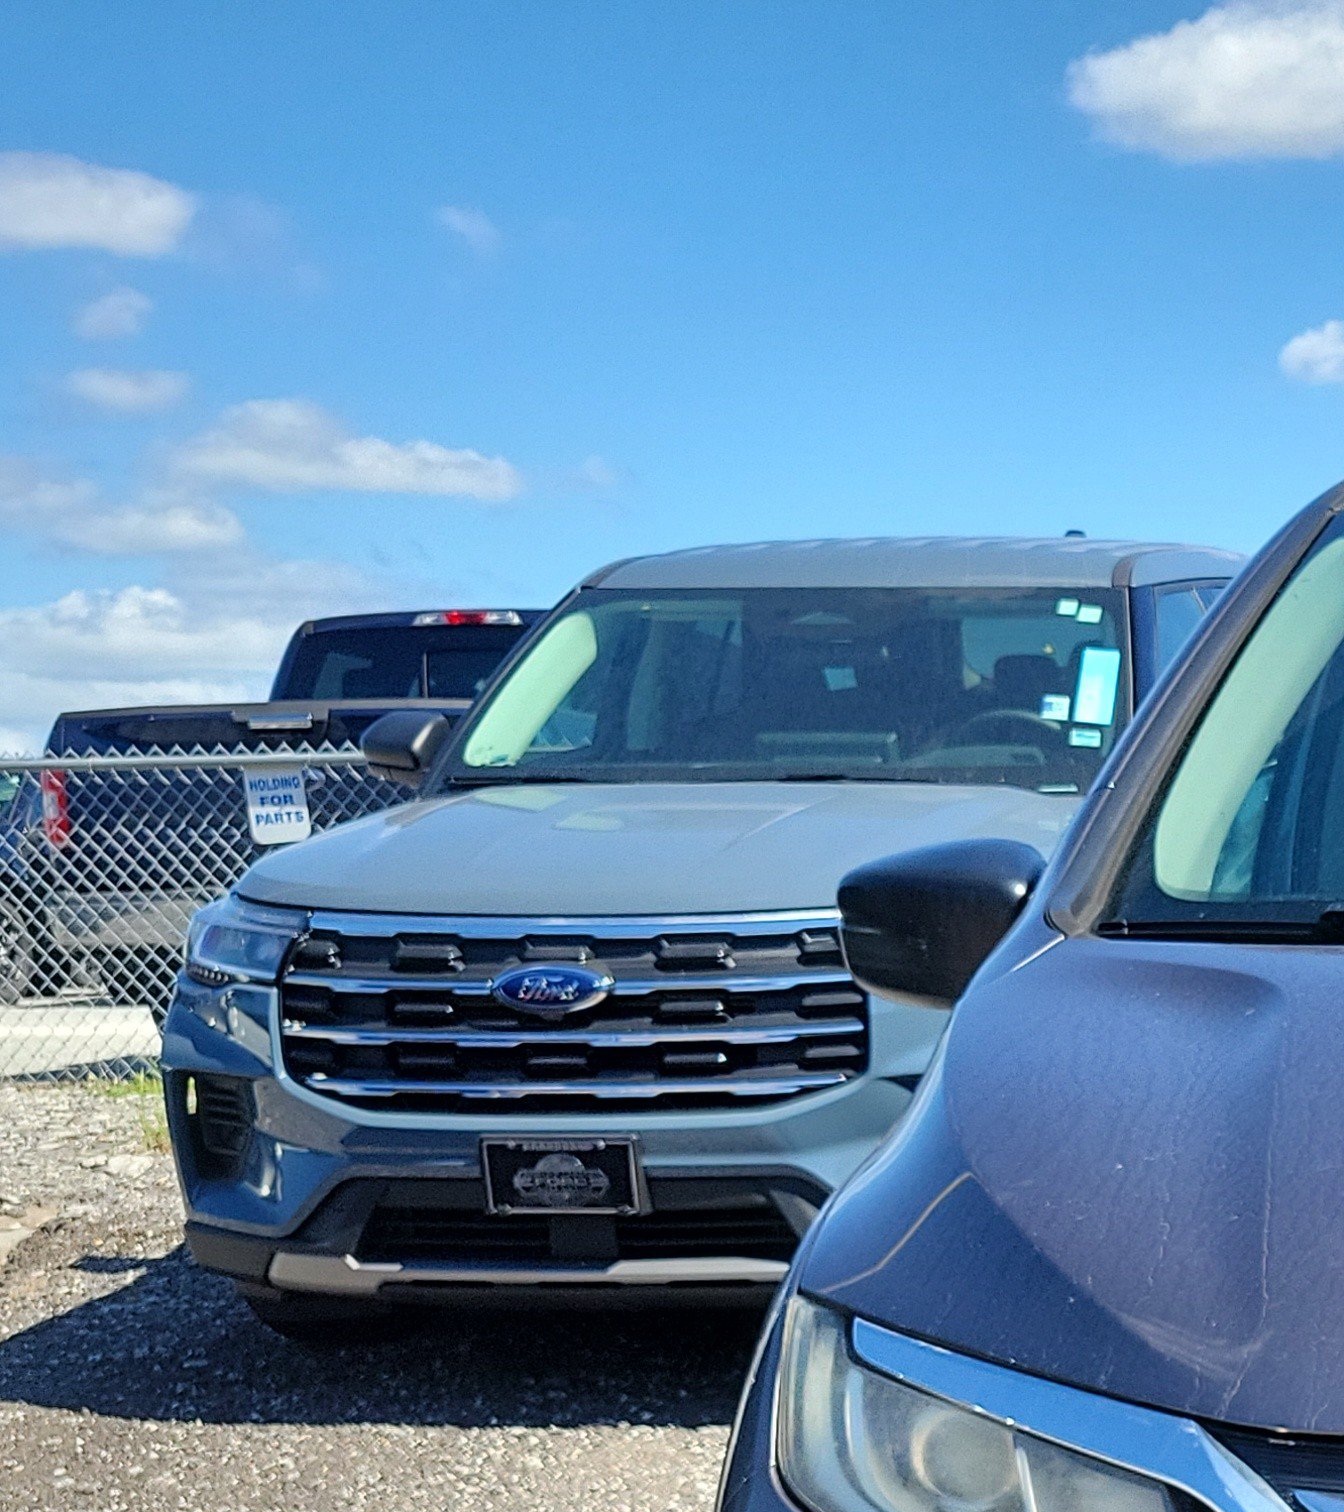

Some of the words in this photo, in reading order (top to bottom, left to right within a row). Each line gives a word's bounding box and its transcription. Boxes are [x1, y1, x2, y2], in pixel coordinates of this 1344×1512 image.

[249, 776, 300, 791] HOLDING
[259, 794, 295, 806] FOR
[255, 811, 304, 826] PARTS
[517, 977, 580, 1001] Ford
